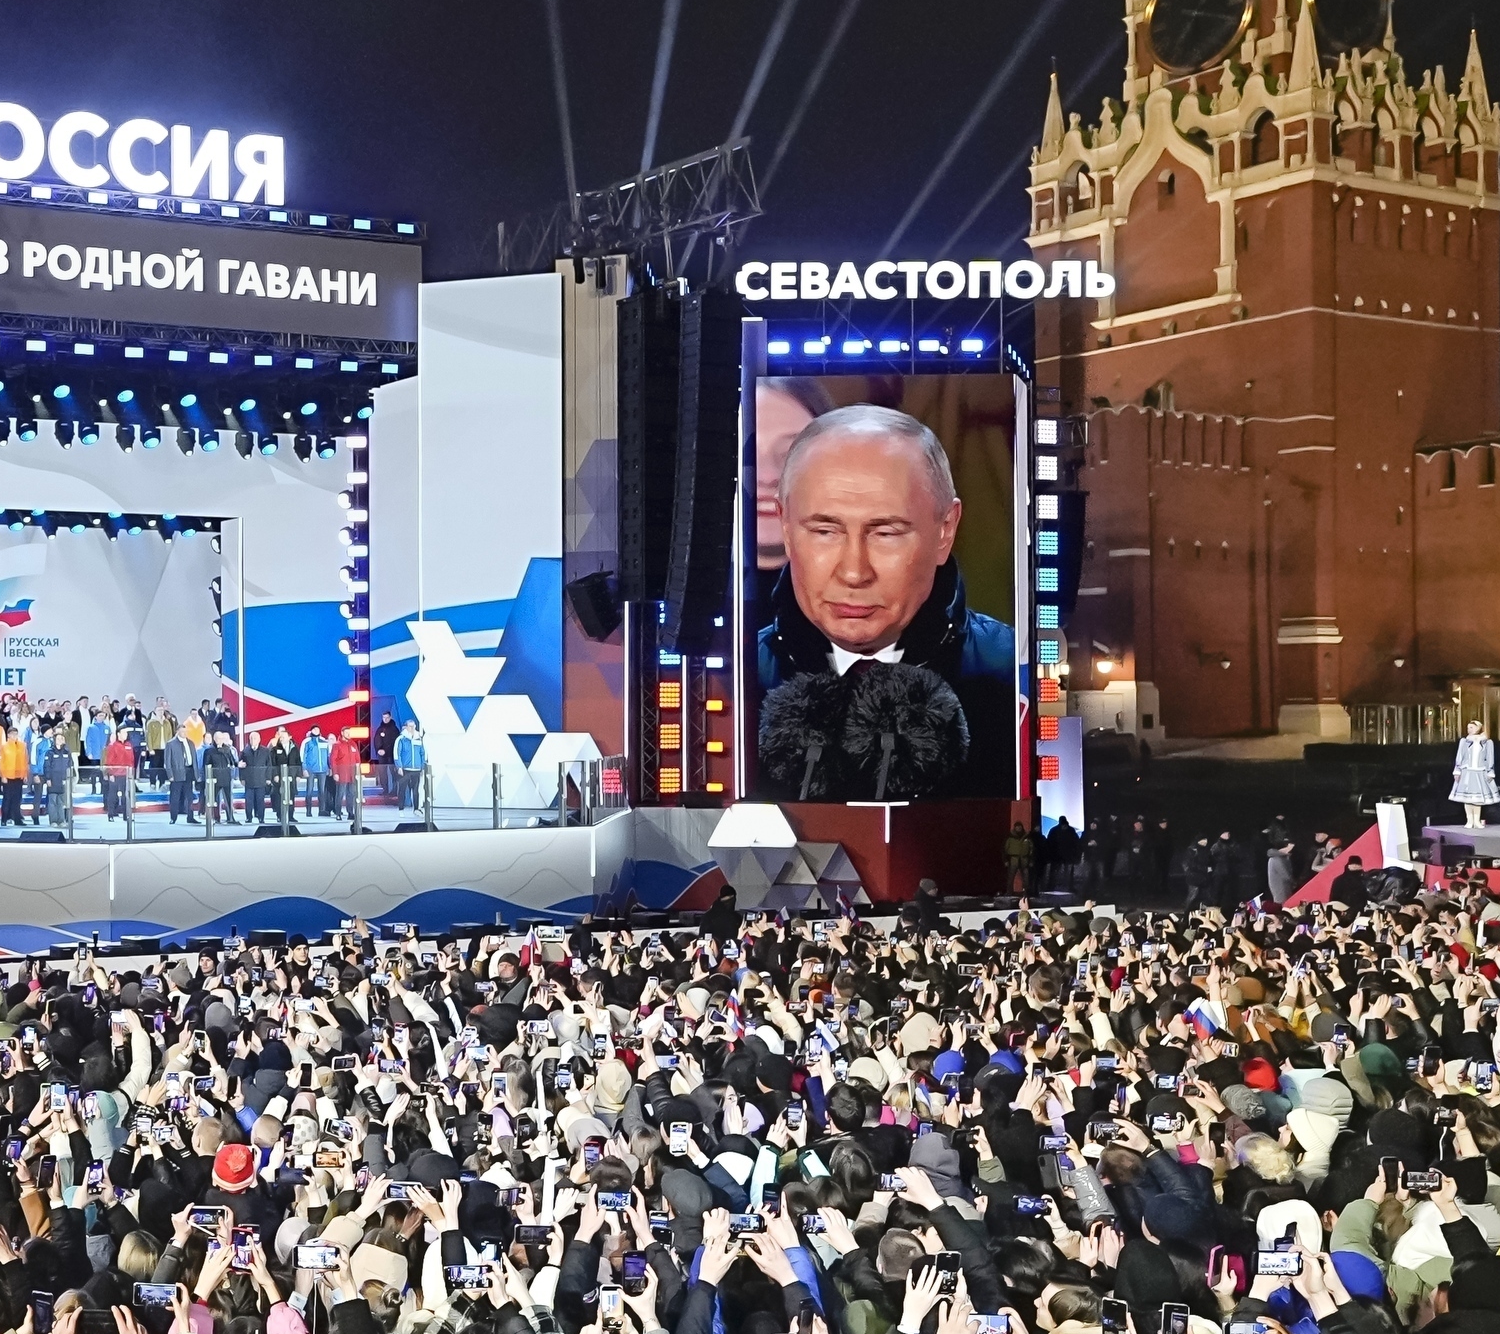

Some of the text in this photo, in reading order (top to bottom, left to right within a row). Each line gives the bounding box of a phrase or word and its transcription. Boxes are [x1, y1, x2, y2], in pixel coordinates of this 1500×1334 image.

[22, 241, 204, 292] РОДНОЙ
[218, 258, 378, 307] ГАВАНИ
[735, 260, 1117, 301] СЕВАСТОПОЛЬ
[8, 637, 59, 647] РУССКАЯ
[8, 648, 46, 658] ВЕСНА
